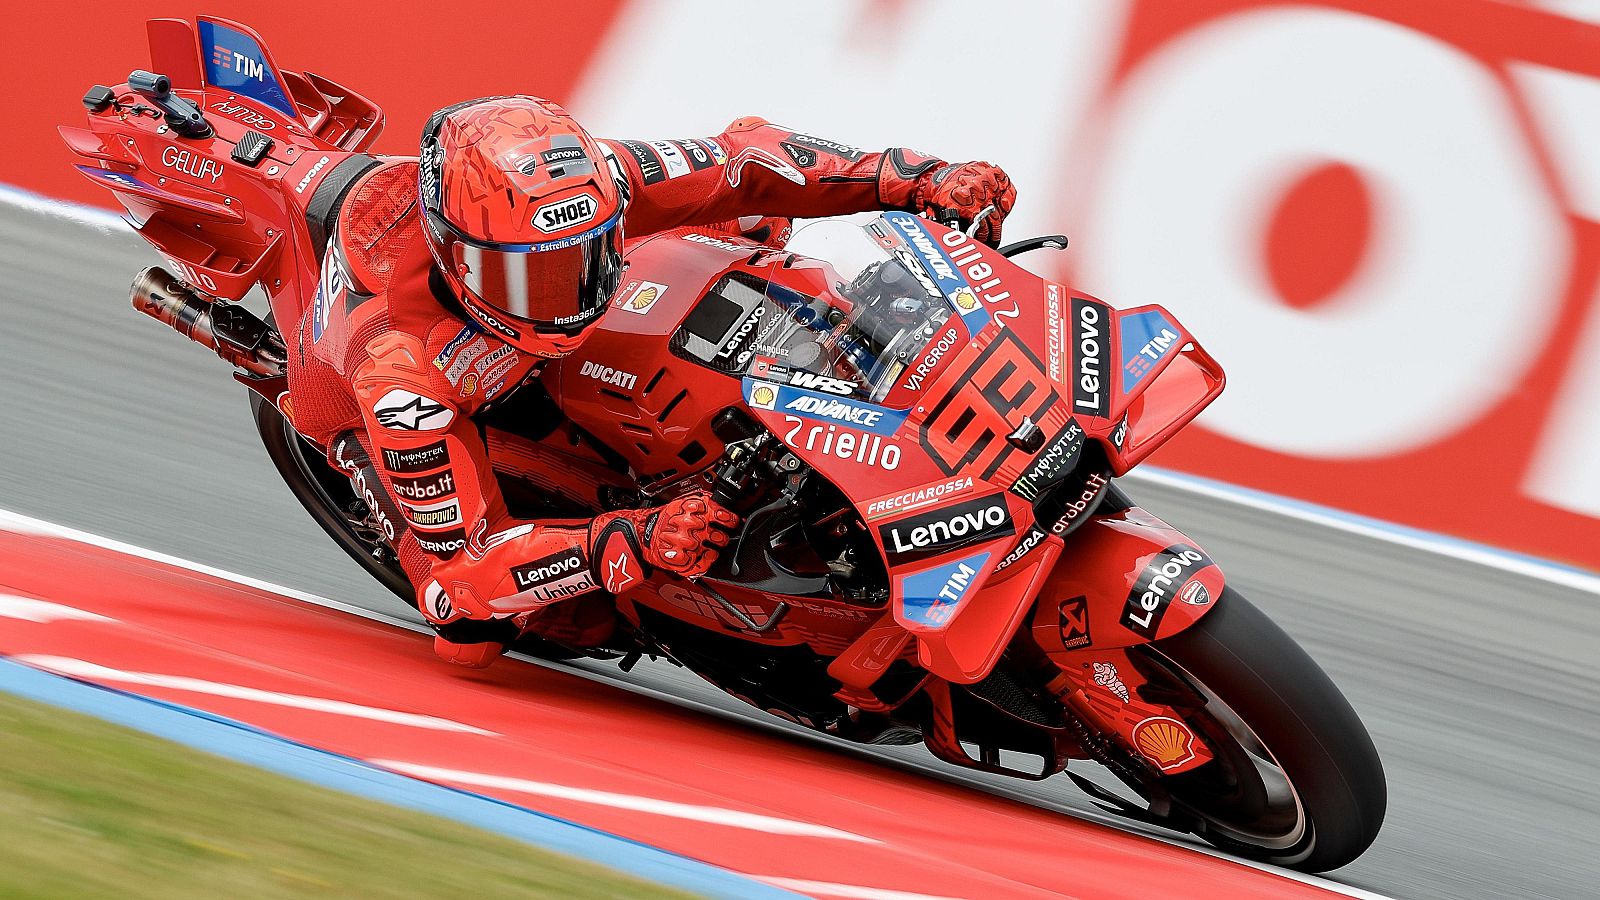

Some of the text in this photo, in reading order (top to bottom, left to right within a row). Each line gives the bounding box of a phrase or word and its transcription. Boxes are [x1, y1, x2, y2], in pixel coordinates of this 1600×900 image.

[233, 51, 264, 82] TIM
[211, 101, 277, 131] GELLIFY
[162, 146, 224, 185] GELLIFY
[545, 150, 581, 161] Lenovo
[794, 135, 858, 159] Lenovo
[296, 155, 330, 195] DUCATI
[542, 199, 592, 228] SHOEI
[540, 238, 570, 252] Estrella
[570, 233, 594, 246] Galicia
[684, 233, 742, 252] DUCATI
[900, 216, 960, 281] ADVANCE
[894, 250, 943, 298] WRS
[942, 231, 1011, 303] riello
[464, 297, 515, 336] Lenovo
[554, 307, 595, 326] Insta360
[717, 305, 767, 359] Lenovo
[1048, 284, 1059, 382] FRECCIAROSSA
[756, 343, 789, 356] MARQUEZ
[903, 327, 958, 391] VARGROUP
[1075, 305, 1100, 410] Lenovo
[1140, 328, 1178, 360] TIM
[580, 360, 637, 390] DUCATI
[769, 364, 787, 373] Lenovo
[789, 371, 859, 395] WRS
[786, 395, 883, 427] ADVANCE
[400, 446, 444, 464] MONSTER
[805, 424, 901, 471] riello
[1028, 424, 1082, 482] MONSTER
[1047, 440, 1082, 480] ENERGY
[393, 474, 453, 498] aruba.it
[867, 476, 974, 516] FRECCIAROSSA
[1052, 471, 1107, 534] aruba.it
[891, 505, 1005, 553] Lenovo
[517, 556, 581, 586] Lenovo
[994, 530, 1045, 573] RRERA
[533, 575, 595, 602] Unipol
[939, 562, 976, 601] TIM
[1129, 549, 1202, 629] Lenovo
